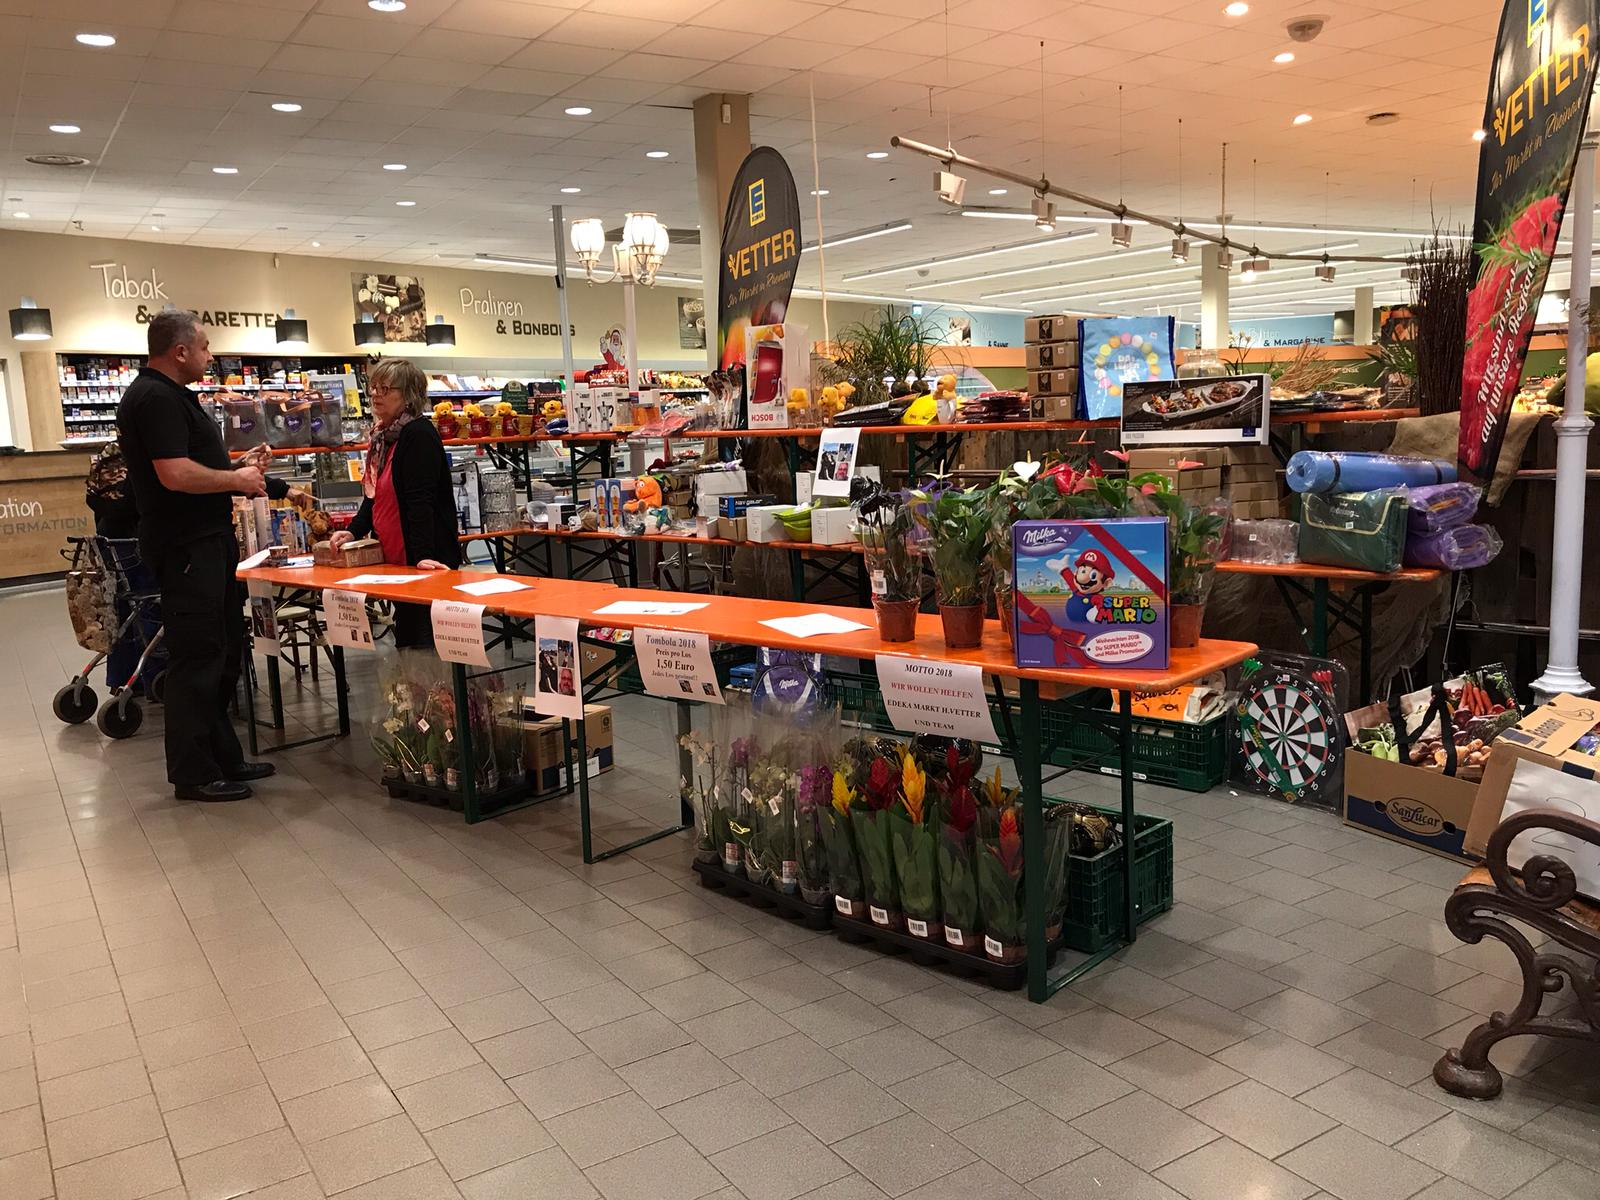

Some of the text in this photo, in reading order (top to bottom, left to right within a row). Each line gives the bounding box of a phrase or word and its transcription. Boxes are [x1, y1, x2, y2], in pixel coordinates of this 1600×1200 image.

[1494, 23, 1590, 147] VETTER
[727, 228, 796, 280] VETTER
[90, 263, 169, 300] Tabak
[460, 287, 523, 317] Pralinen
[135, 304, 154, 325] &
[496, 319, 507, 335] &
[1263, 339, 1270, 347] &
[1490, 311, 1508, 360] sind
[1481, 401, 1499, 443] auf
[1491, 339, 1515, 409] unsere
[751, 413, 774, 422] BOSCH
[1022, 526, 1057, 544] Milka
[1103, 596, 1150, 609] SUPER
[1095, 607, 1157, 624] MARIO
[646, 634, 697, 649] Tombola 2018
[655, 648, 670, 656] Preis
[681, 650, 692, 658] Los
[657, 658, 695, 672] 1,50 Euro
[905, 663, 953, 677] MOTTO 2018
[891, 682, 974, 699] WIR WOLLEN HELFEN
[1304, 688, 1313, 697] 20
[887, 699, 981, 718] EDEKA MARKT H.VETTER
[914, 719, 954, 730] UND TEAM
[1326, 715, 1334, 726] 18
[1328, 754, 1336, 762] 13
[1311, 781, 1319, 791] 10
[1390, 801, 1441, 827] SanLucar
